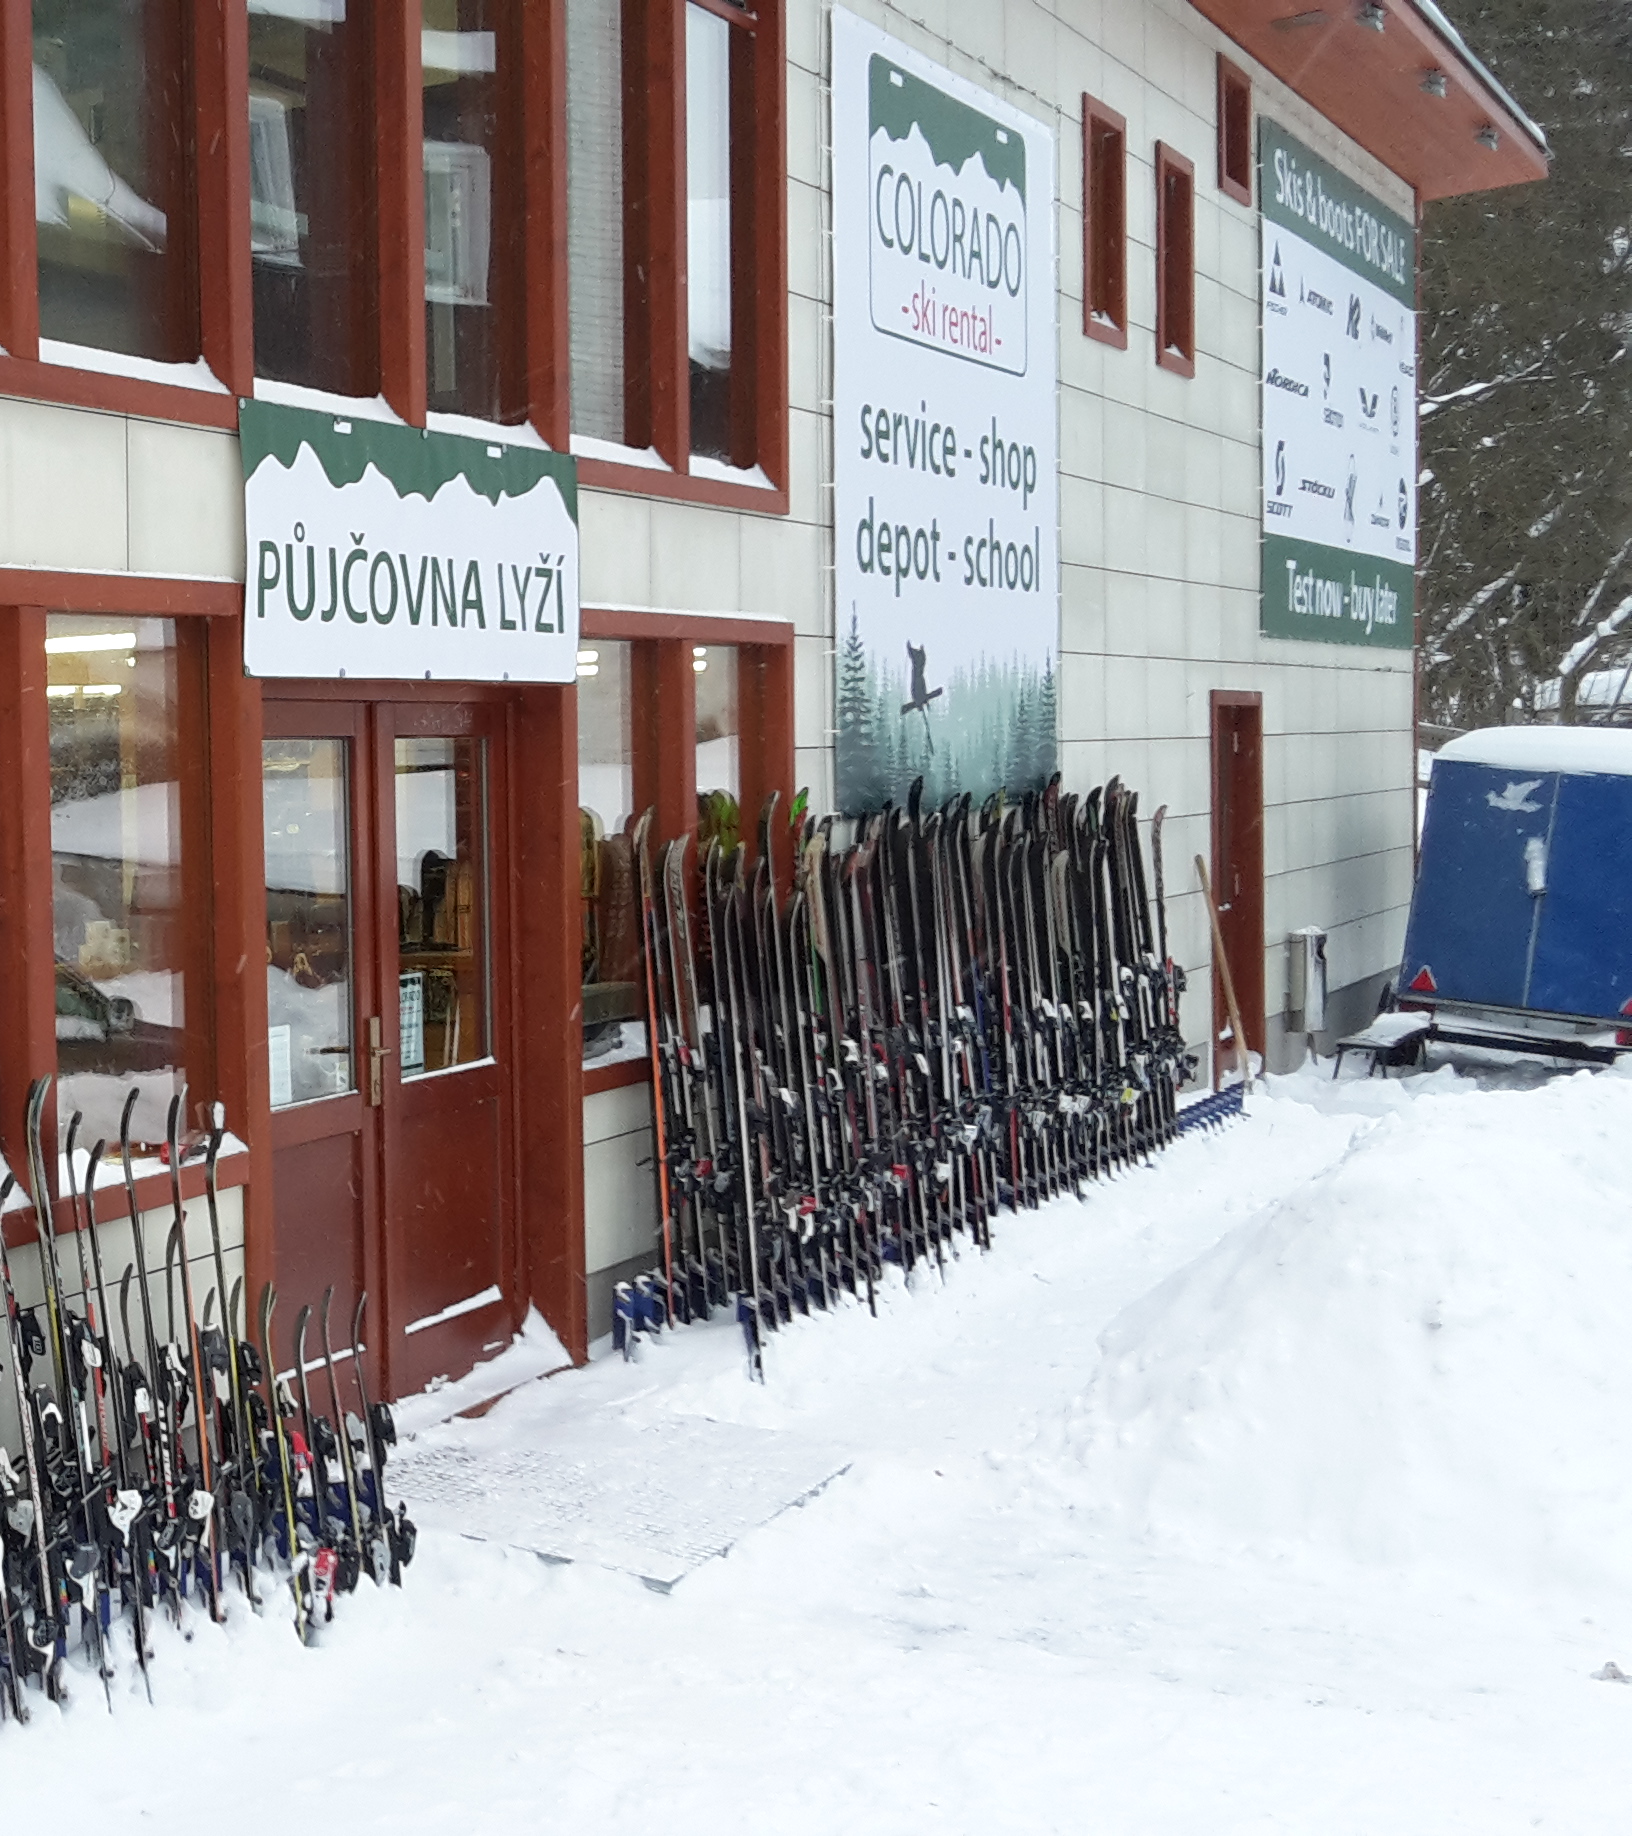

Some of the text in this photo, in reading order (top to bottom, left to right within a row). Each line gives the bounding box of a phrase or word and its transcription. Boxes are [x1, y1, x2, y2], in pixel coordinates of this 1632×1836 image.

[876, 164, 1022, 297] COLORADO
[1273, 148, 1406, 285] Skis & boots FOR SALE
[859, 400, 957, 478] service
[979, 416, 1037, 511] shop
[257, 522, 566, 634] PŮJČOVNA LYŽÍ
[856, 496, 942, 598] depot
[963, 517, 1041, 593] school
[1286, 559, 1313, 614] Test
[1315, 578, 1344, 617] now
[1350, 569, 1376, 635] buy
[1375, 574, 1398, 625] later
